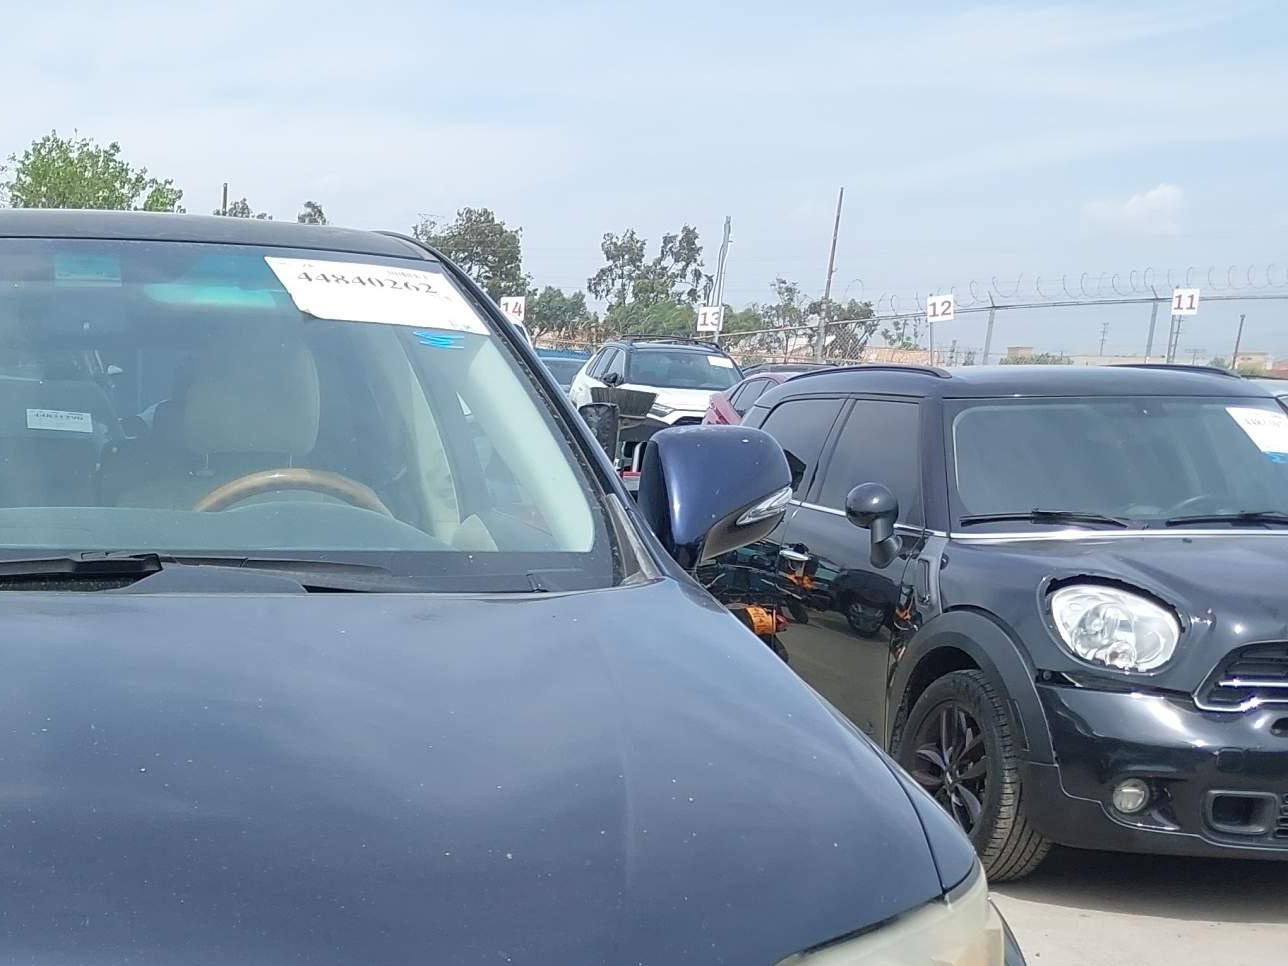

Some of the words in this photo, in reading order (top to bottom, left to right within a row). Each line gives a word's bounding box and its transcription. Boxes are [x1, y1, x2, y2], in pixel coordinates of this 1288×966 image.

[297, 271, 439, 295] 44840262
[502, 301, 523, 317] 14
[928, 300, 952, 318] 12
[1173, 294, 1196, 310] 11
[699, 311, 720, 327] 13
